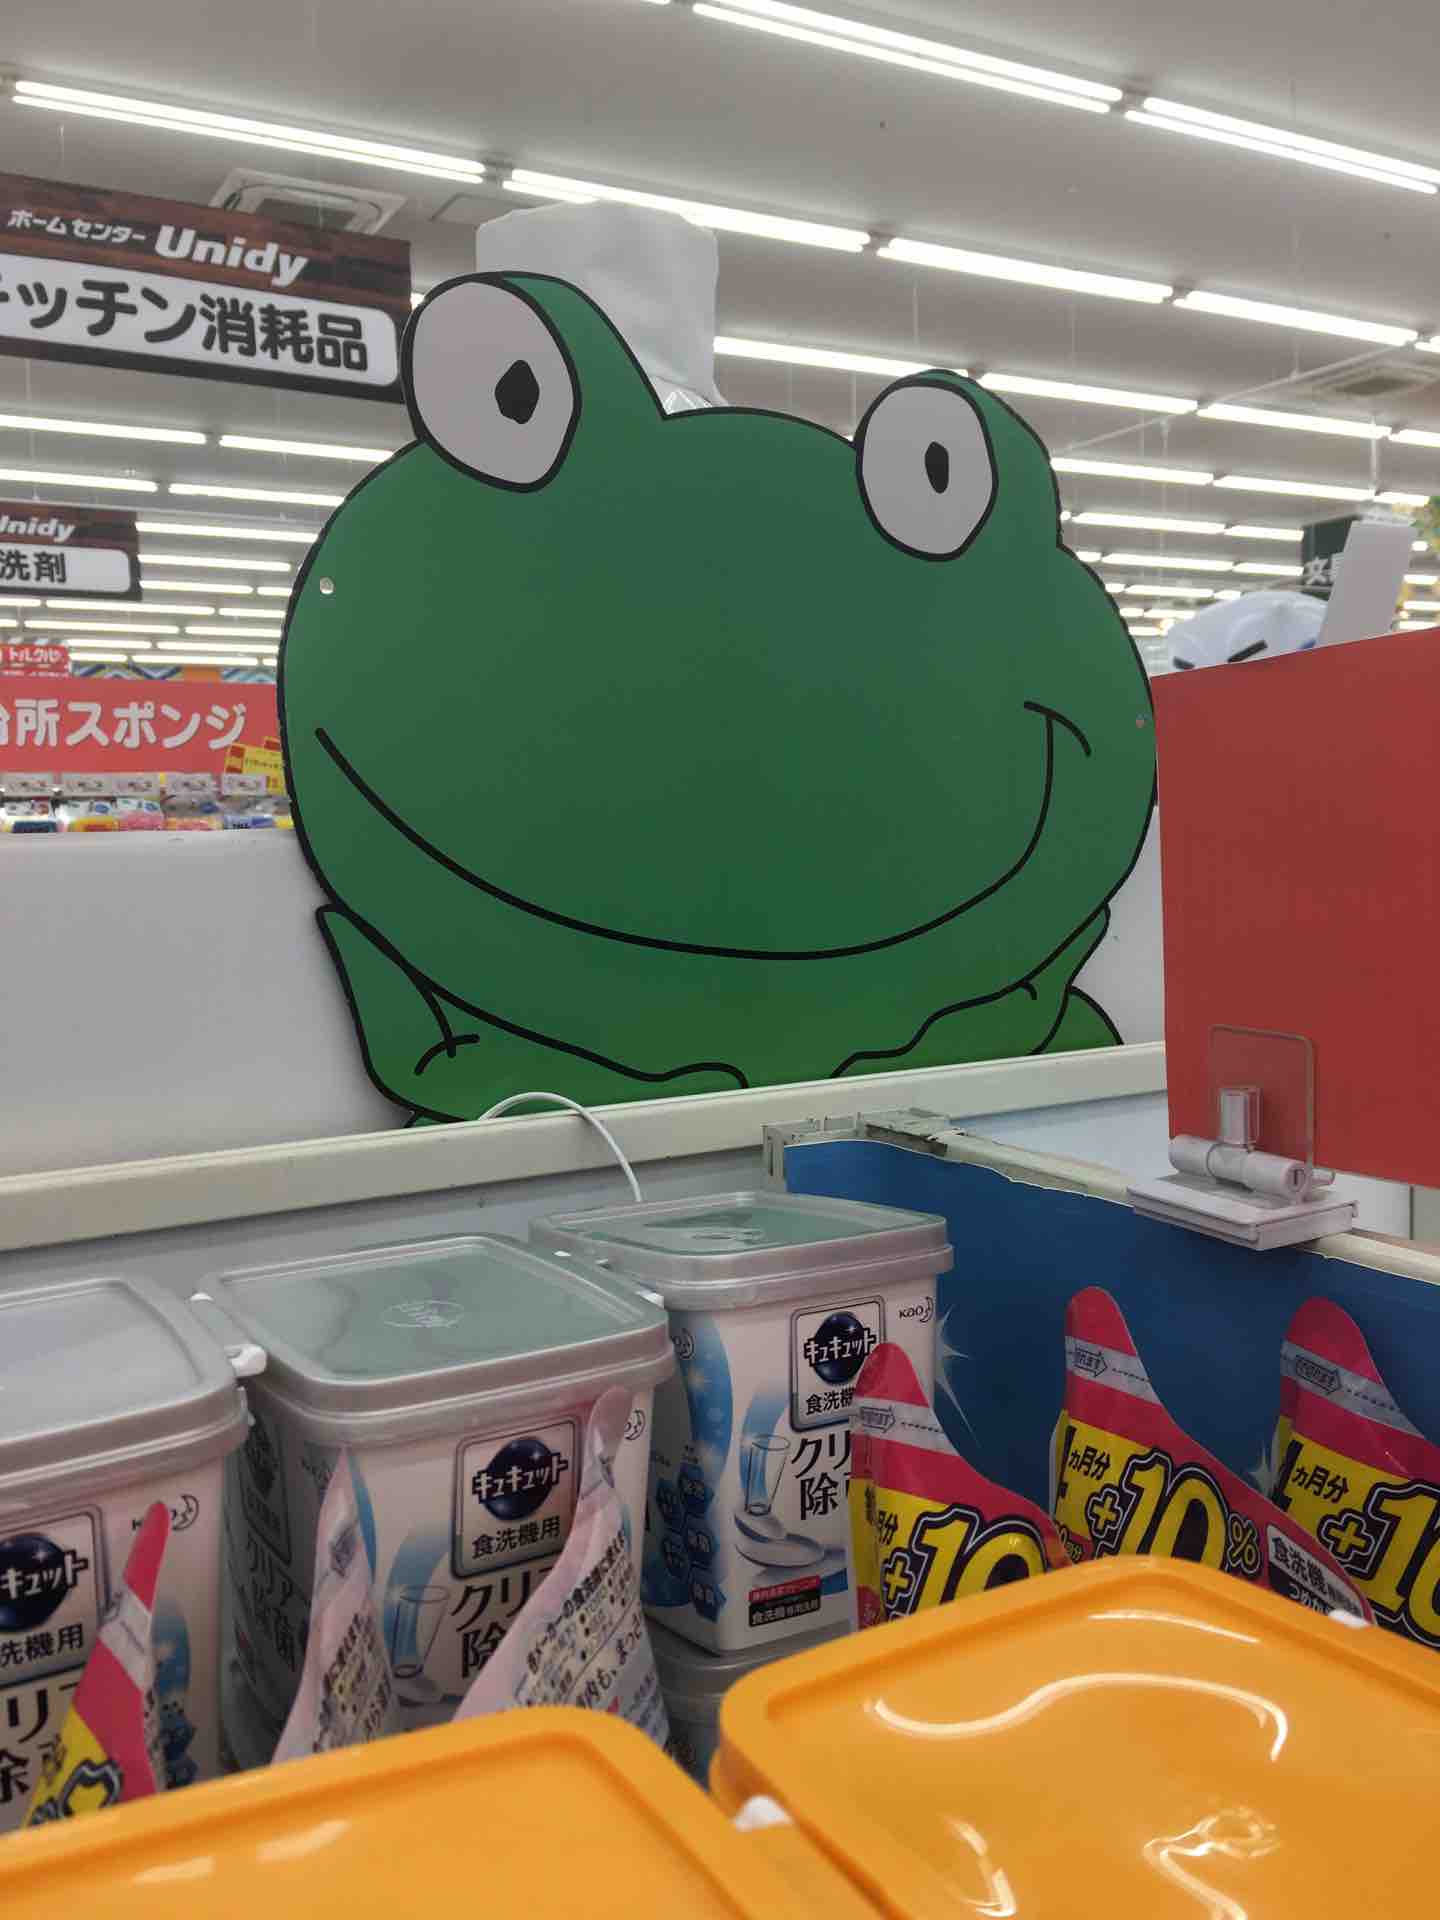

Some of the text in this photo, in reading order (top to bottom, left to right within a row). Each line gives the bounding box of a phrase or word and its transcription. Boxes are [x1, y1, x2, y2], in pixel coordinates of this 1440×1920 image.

[8, 208, 309, 288] ホームセンター Unidy
[0, 276, 369, 373] ッチン消耗品
[803, 1327, 876, 1367] キュキュット
[472, 1452, 568, 1503] キュキュット
[800, 1471, 851, 1522] 除
[472, 1515, 561, 1560] 食洗機用
